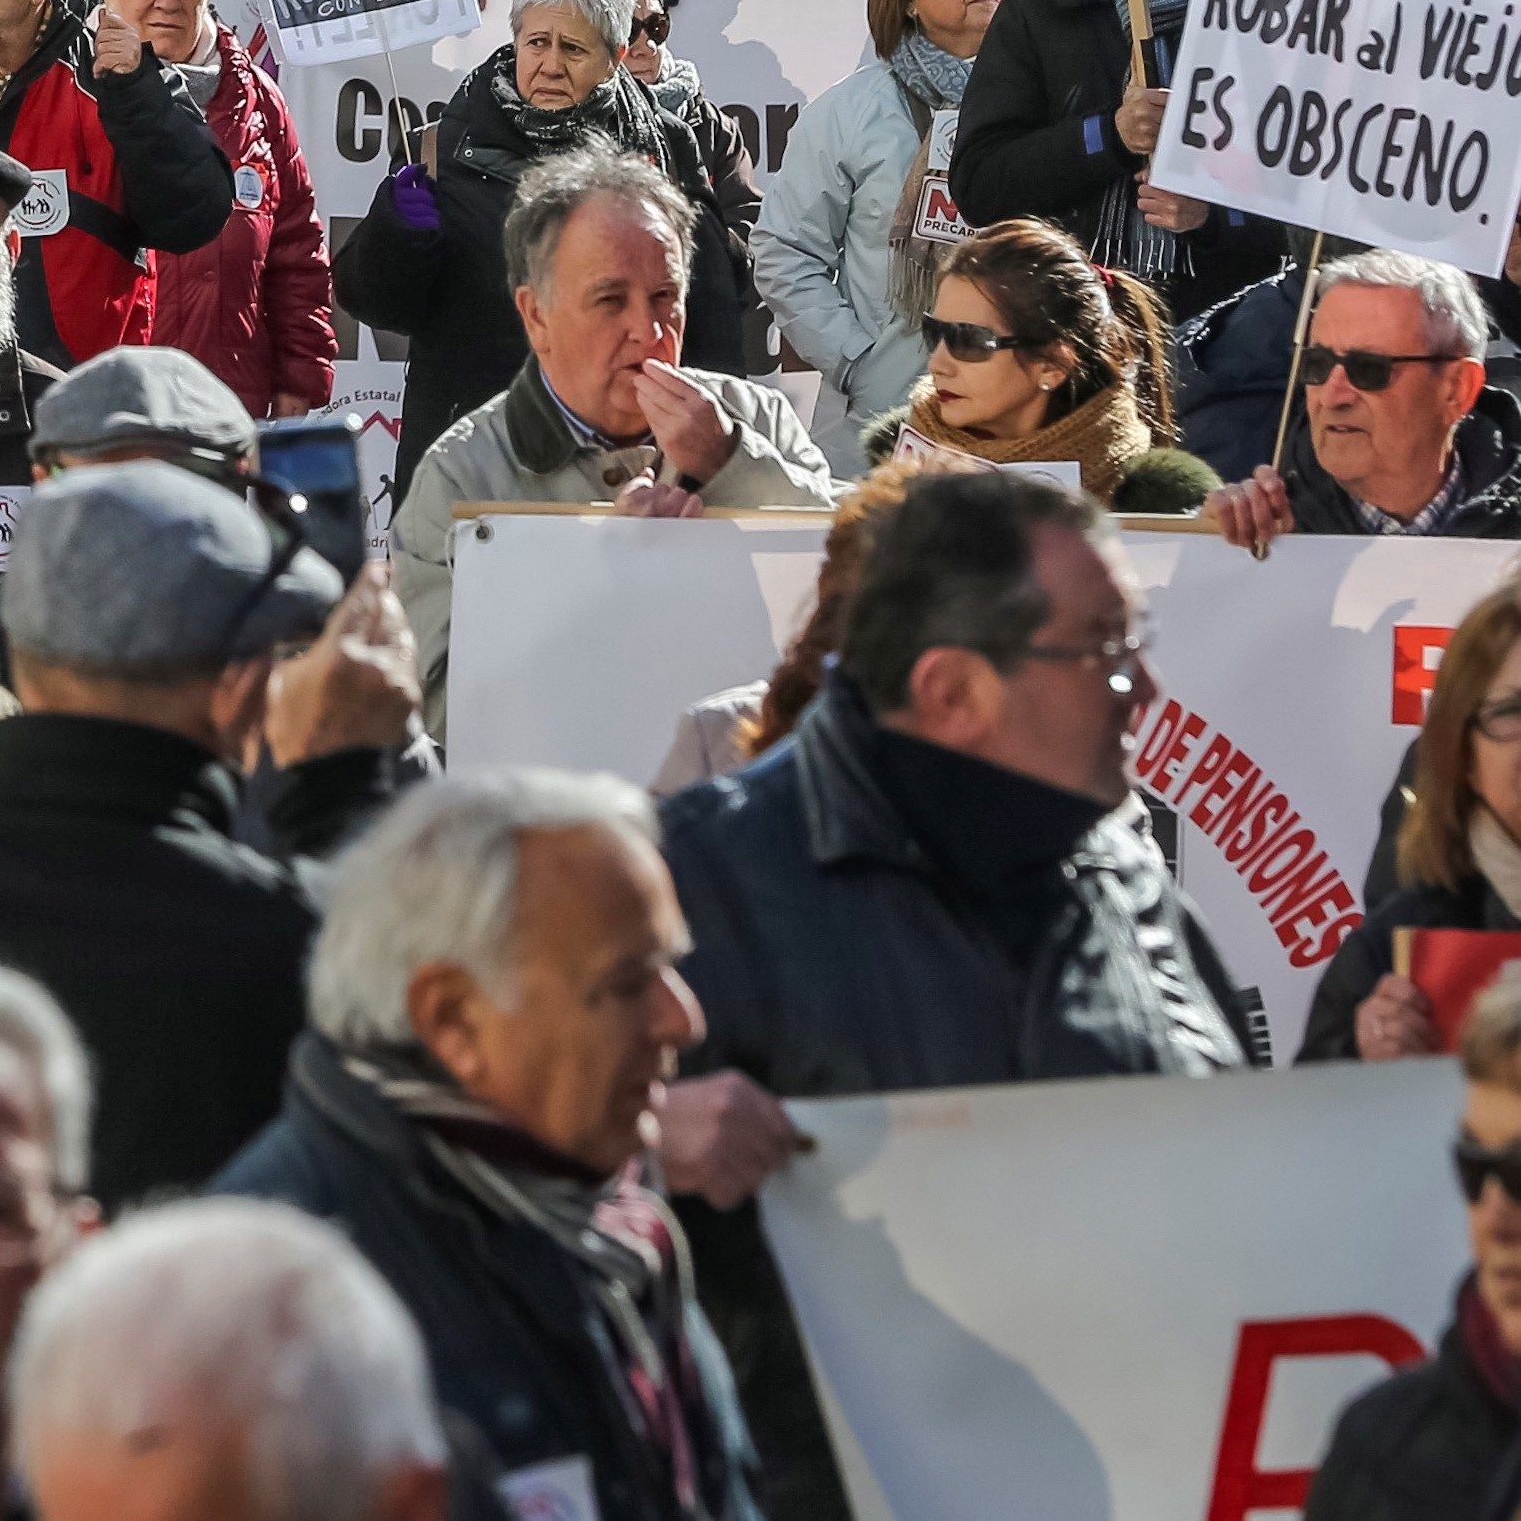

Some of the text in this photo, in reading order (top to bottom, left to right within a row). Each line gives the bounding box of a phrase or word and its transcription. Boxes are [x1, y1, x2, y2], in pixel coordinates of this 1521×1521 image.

[1356, 0, 1403, 75] al
[1181, 66, 1491, 226] ES OBSCENO.
[354, 389, 402, 405] Estatal
[1135, 698, 1366, 969] DE PENSIONES
